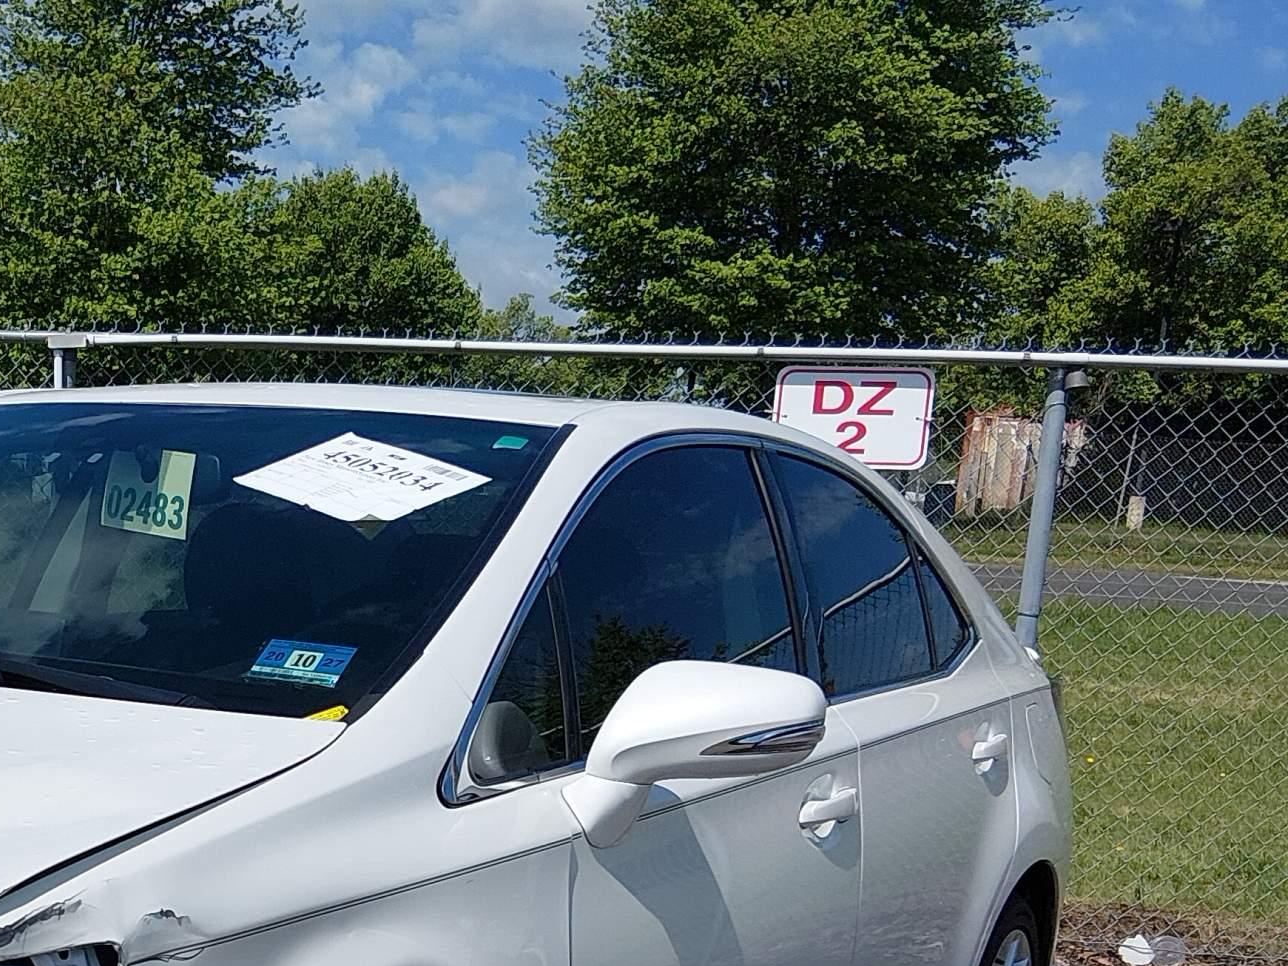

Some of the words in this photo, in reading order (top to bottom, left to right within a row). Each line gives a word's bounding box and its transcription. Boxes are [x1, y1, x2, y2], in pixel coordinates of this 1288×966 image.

[811, 379, 898, 416] DZ
[835, 420, 868, 455] 2
[323, 451, 444, 491] 45052034
[107, 484, 185, 530] 02483
[263, 651, 286, 662] 20
[290, 653, 317, 668] 10
[321, 658, 345, 668] 27
